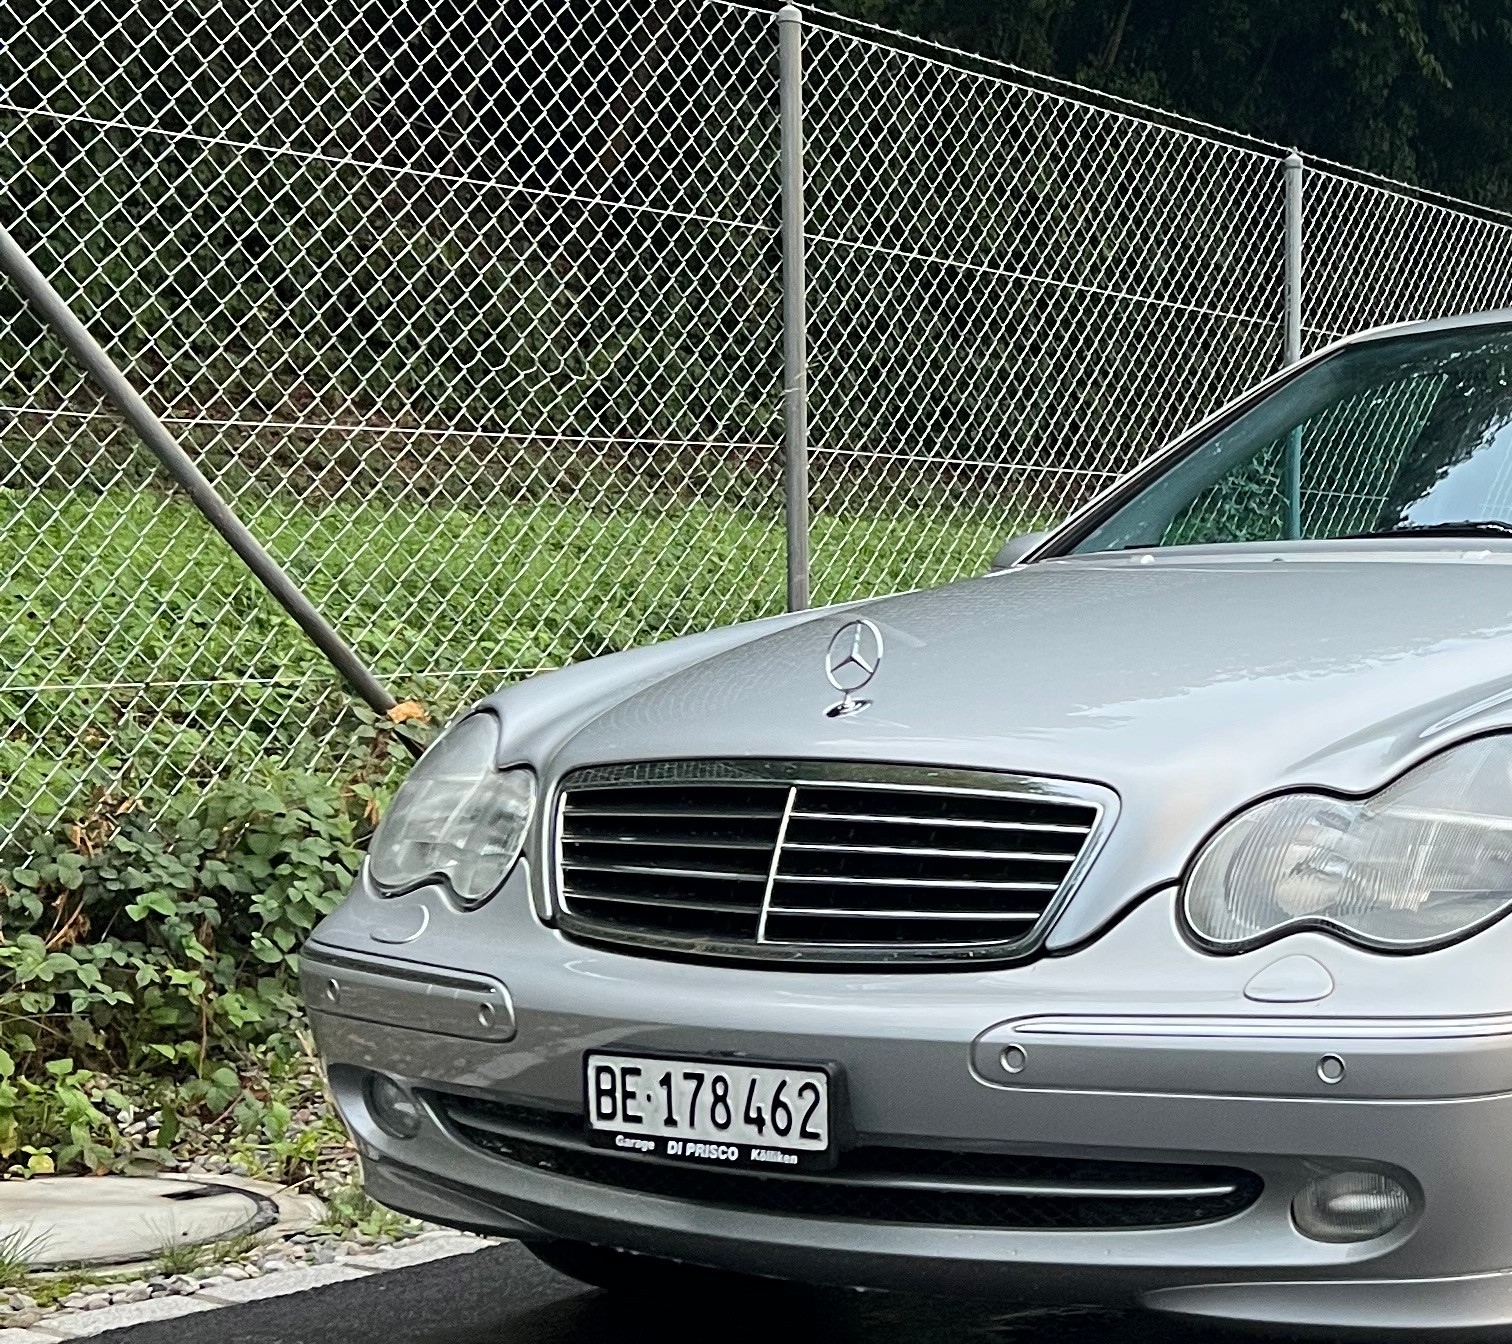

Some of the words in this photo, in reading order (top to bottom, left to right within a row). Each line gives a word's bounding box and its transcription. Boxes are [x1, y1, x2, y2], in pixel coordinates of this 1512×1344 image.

[615, 1134, 656, 1152] Garage
[667, 1140, 683, 1155] DI
[685, 1143, 739, 1161] PRISCO
